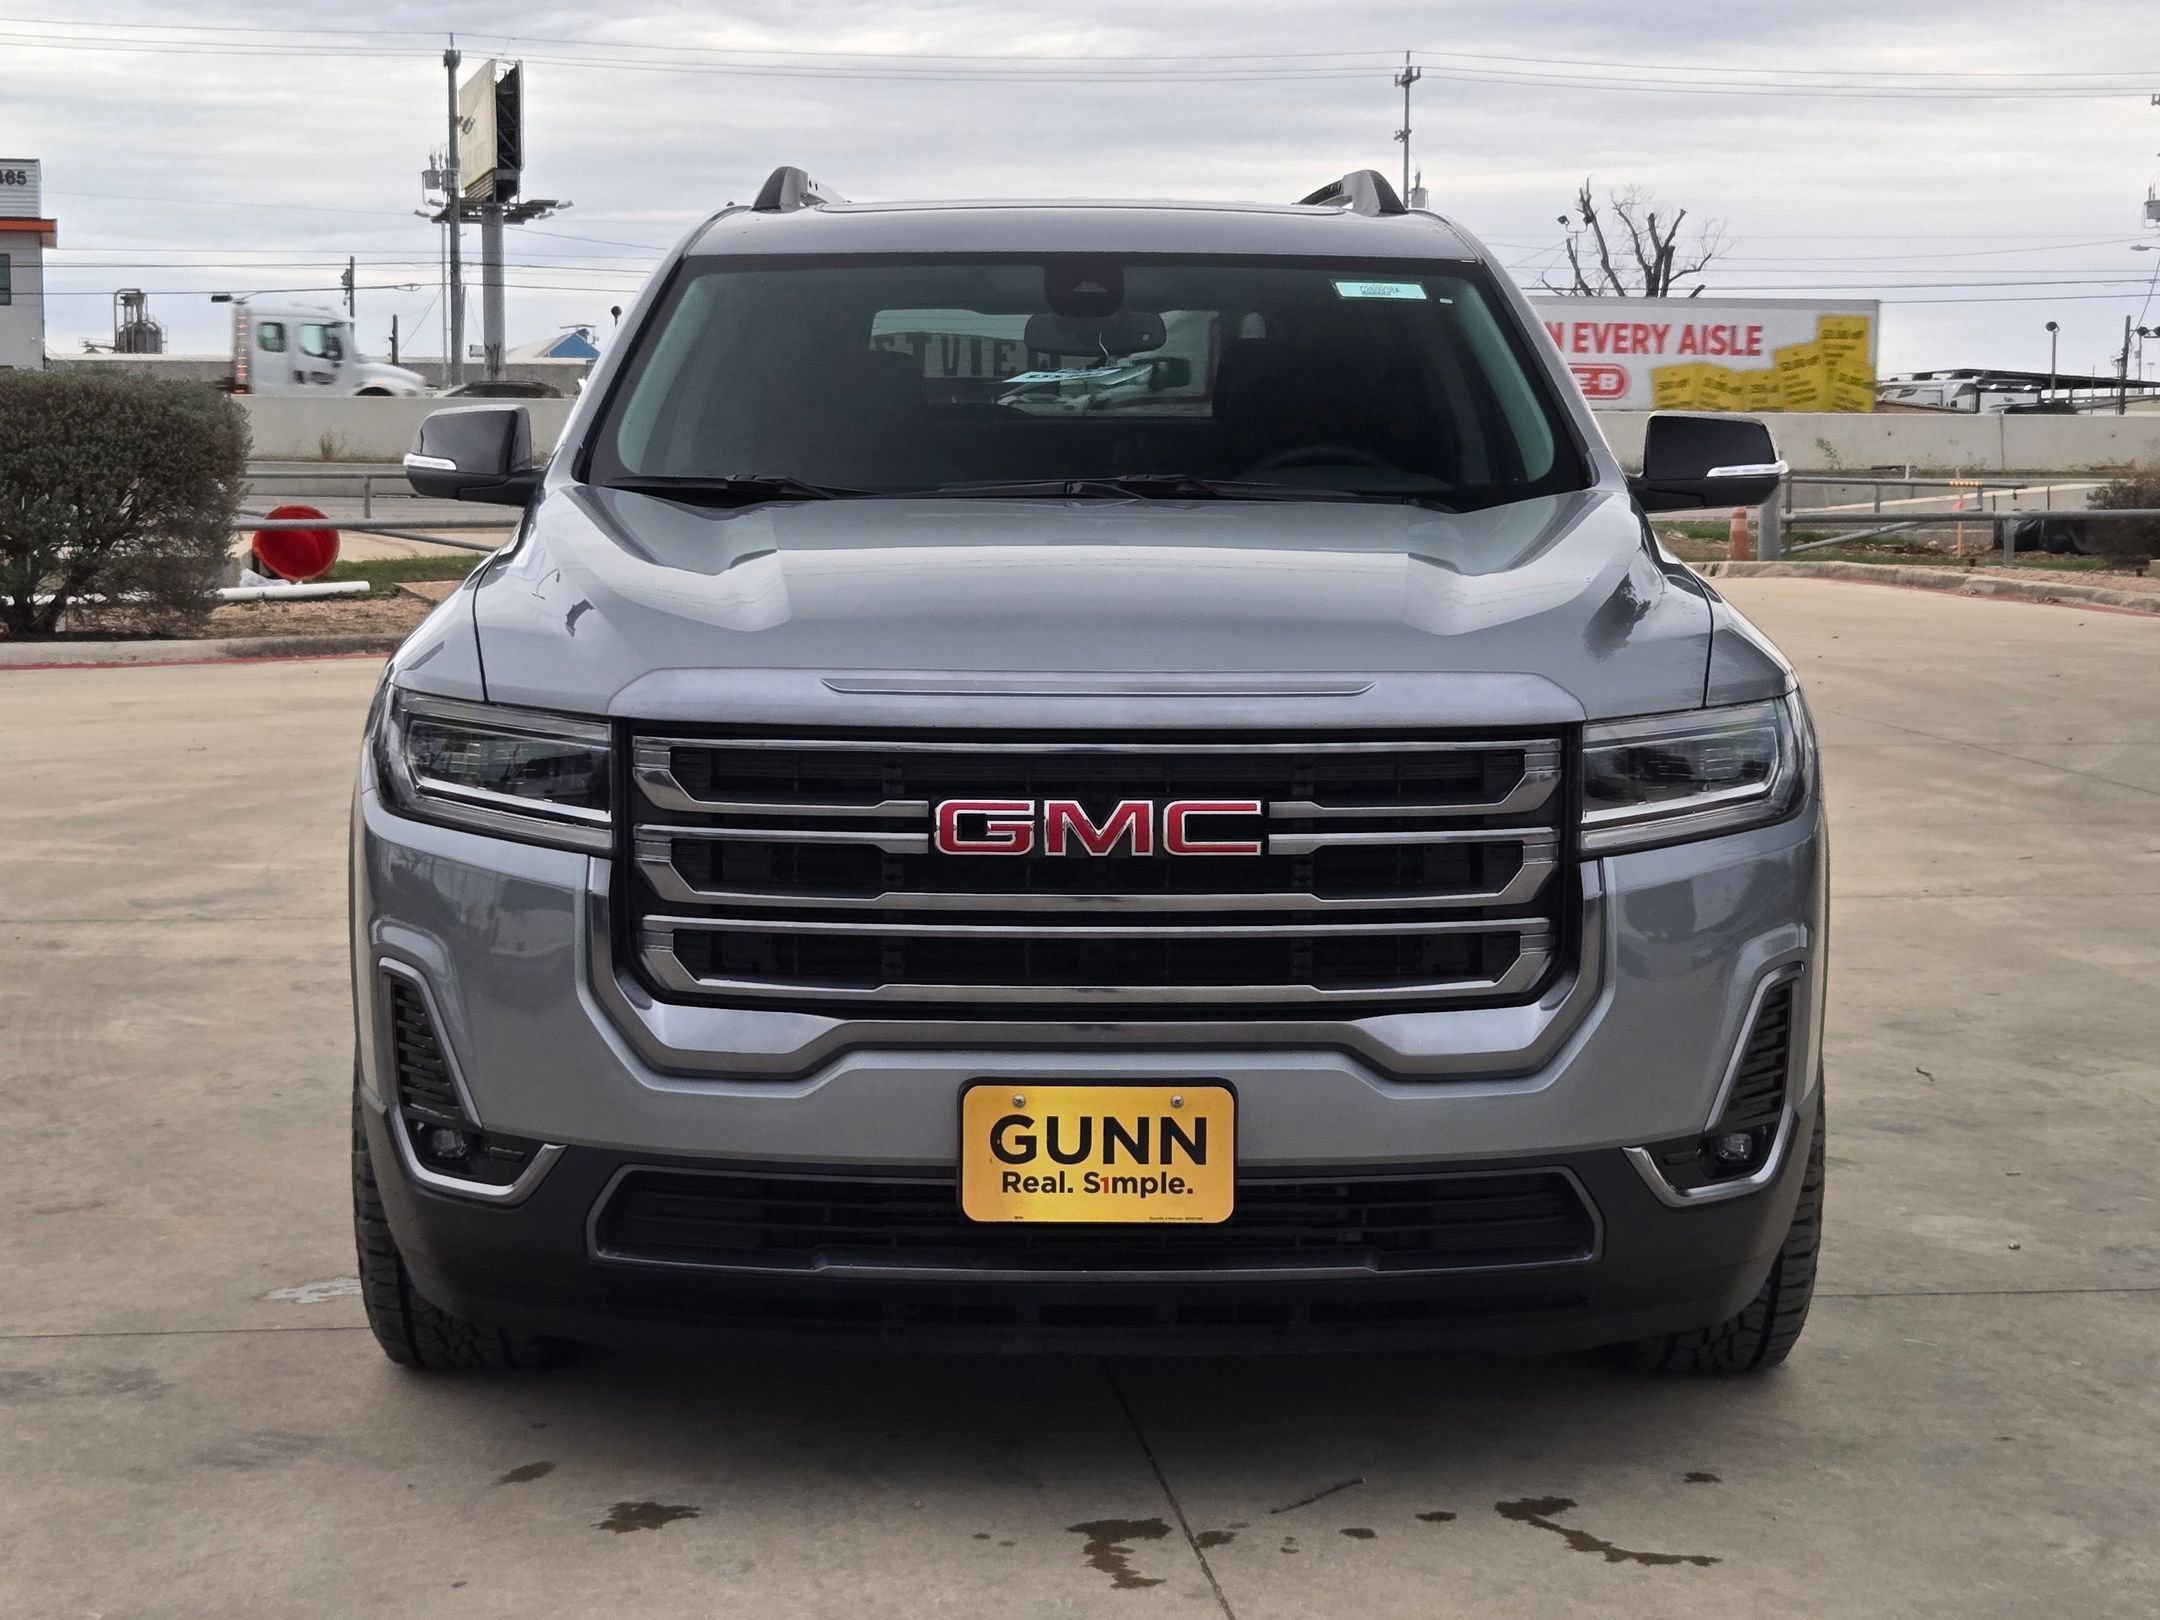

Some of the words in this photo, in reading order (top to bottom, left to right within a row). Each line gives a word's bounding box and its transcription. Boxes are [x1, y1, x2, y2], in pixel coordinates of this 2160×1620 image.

[1572, 321, 1671, 355] EVERY
[1677, 324, 1763, 357] AISLE
[934, 799, 1263, 857] GMC
[990, 1113, 1207, 1165] GUNN
[1002, 1170, 1074, 1194] Real.
[1083, 1171, 1194, 1199] S1mple.
